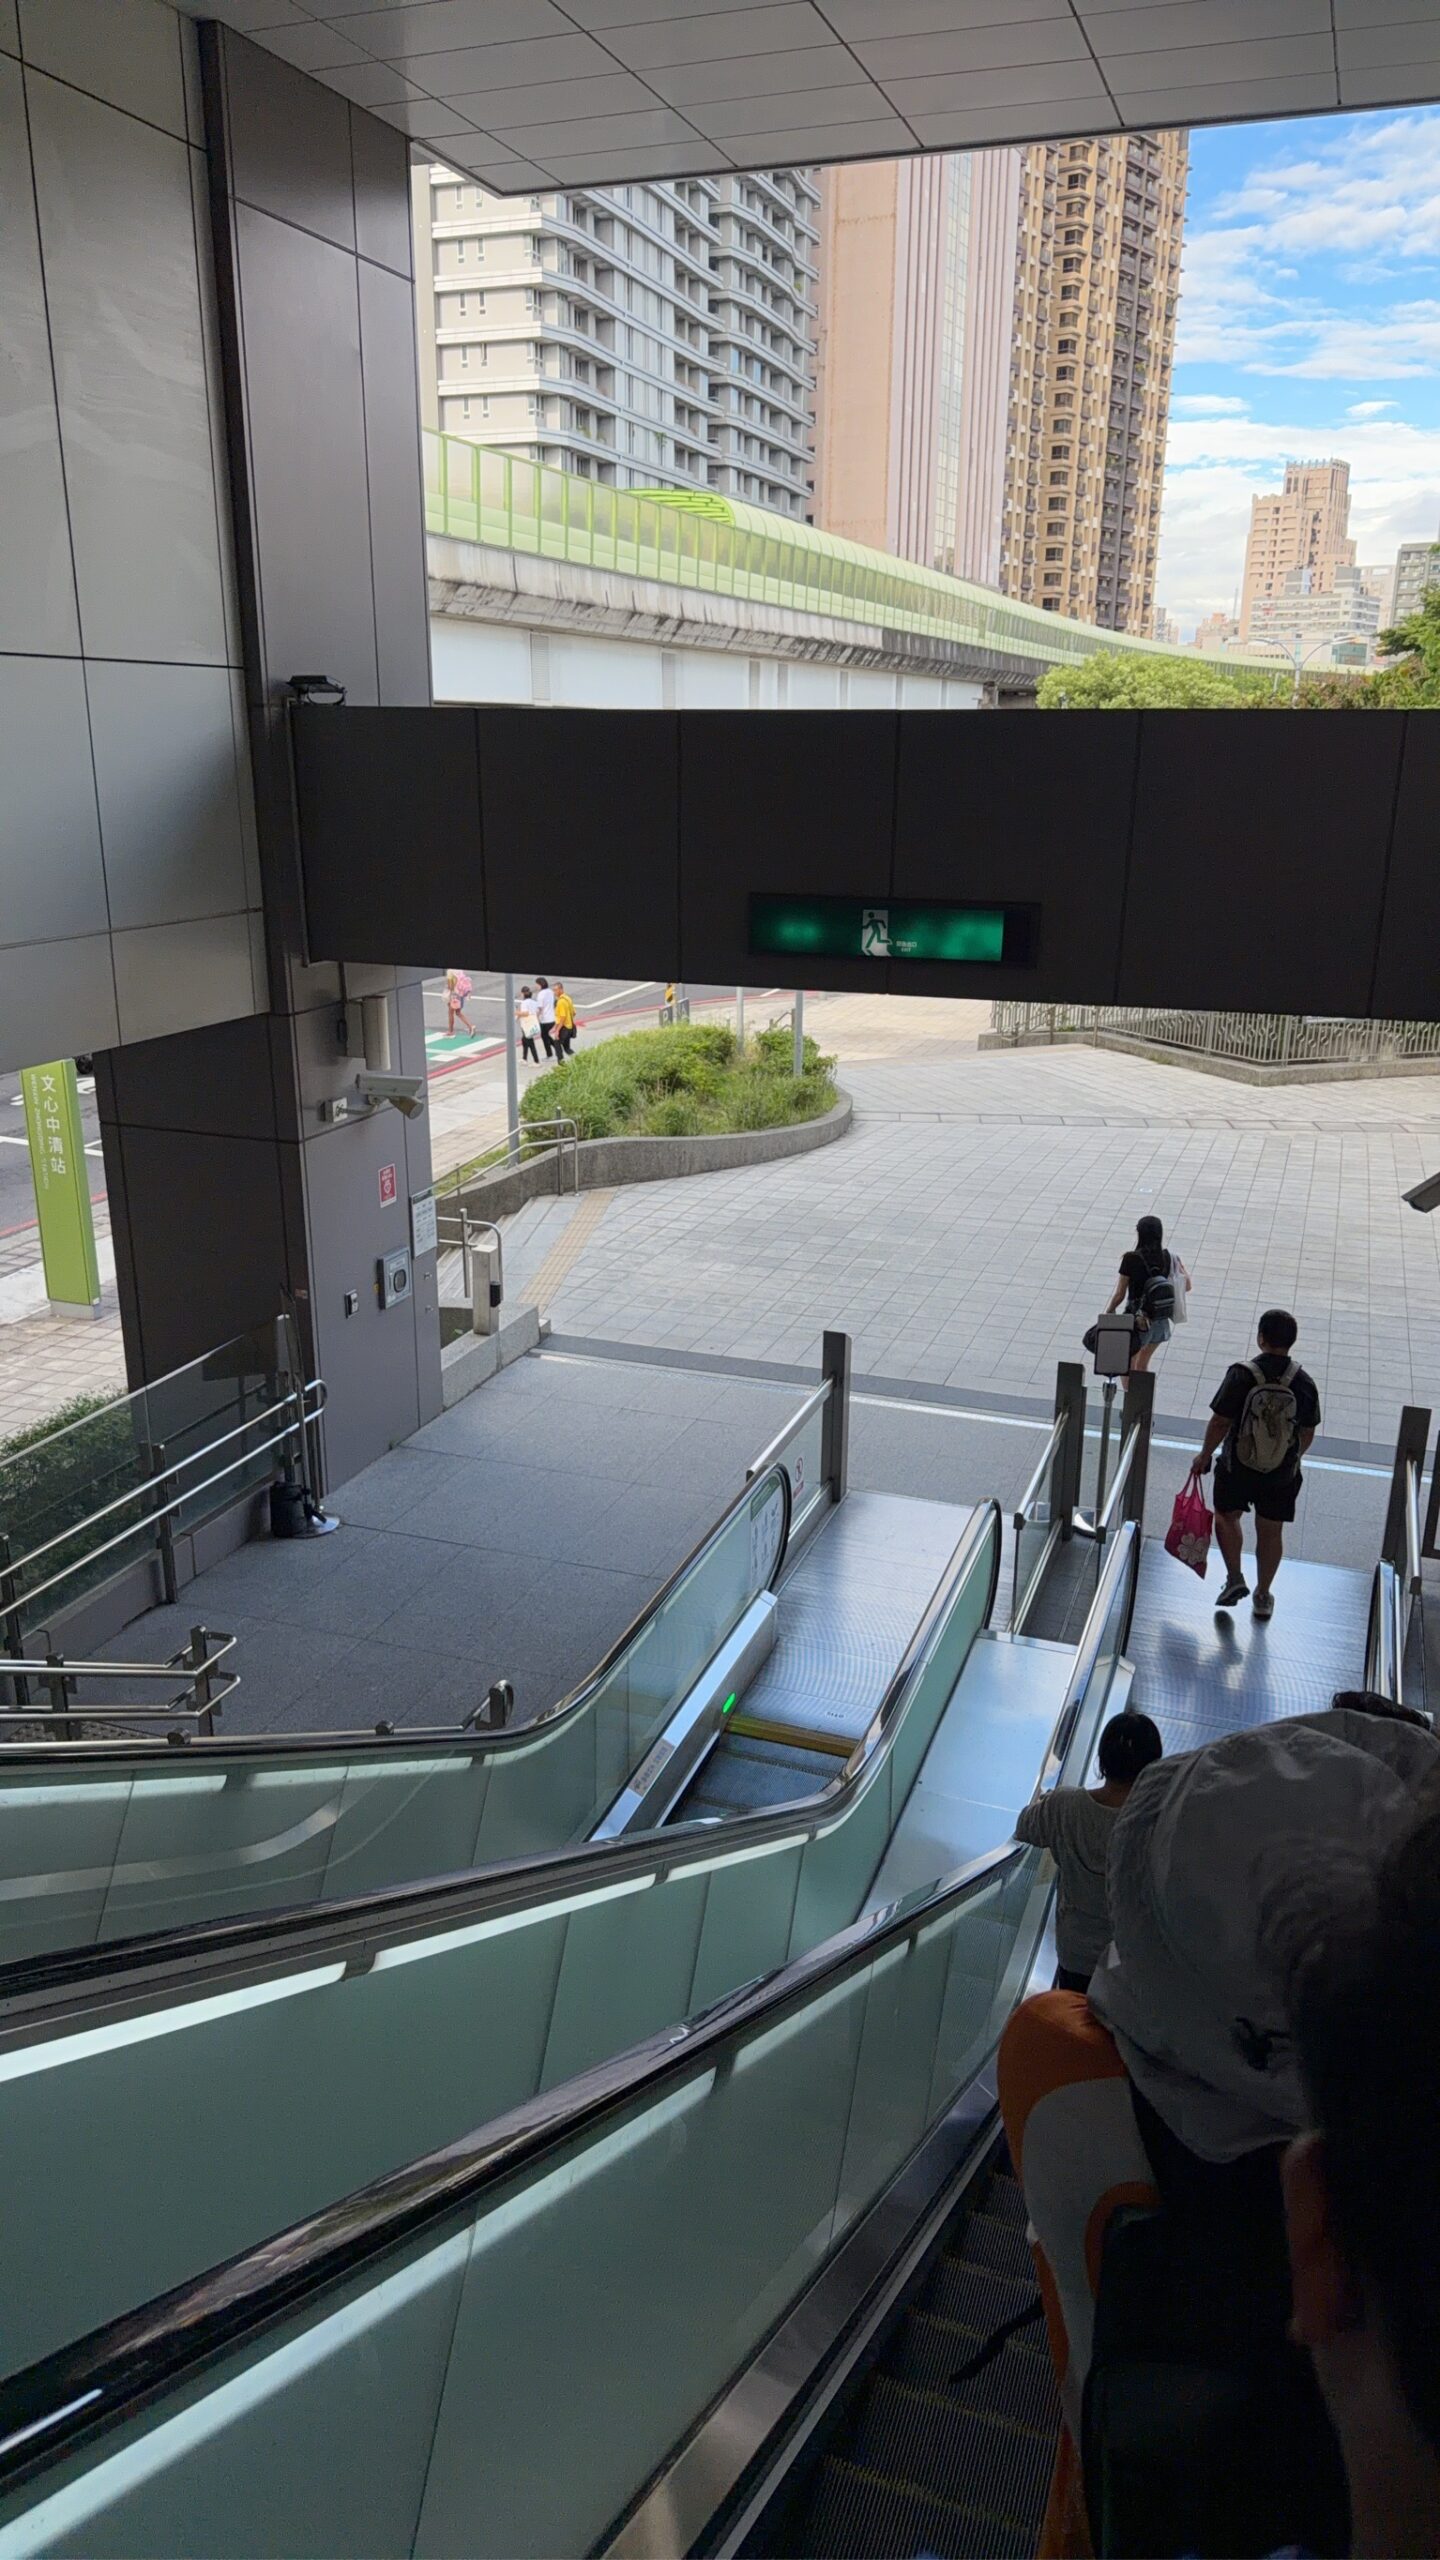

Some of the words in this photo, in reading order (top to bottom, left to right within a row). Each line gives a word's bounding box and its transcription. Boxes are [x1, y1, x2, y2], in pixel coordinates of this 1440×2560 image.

[40, 1074, 66, 1174] 文心中清站
